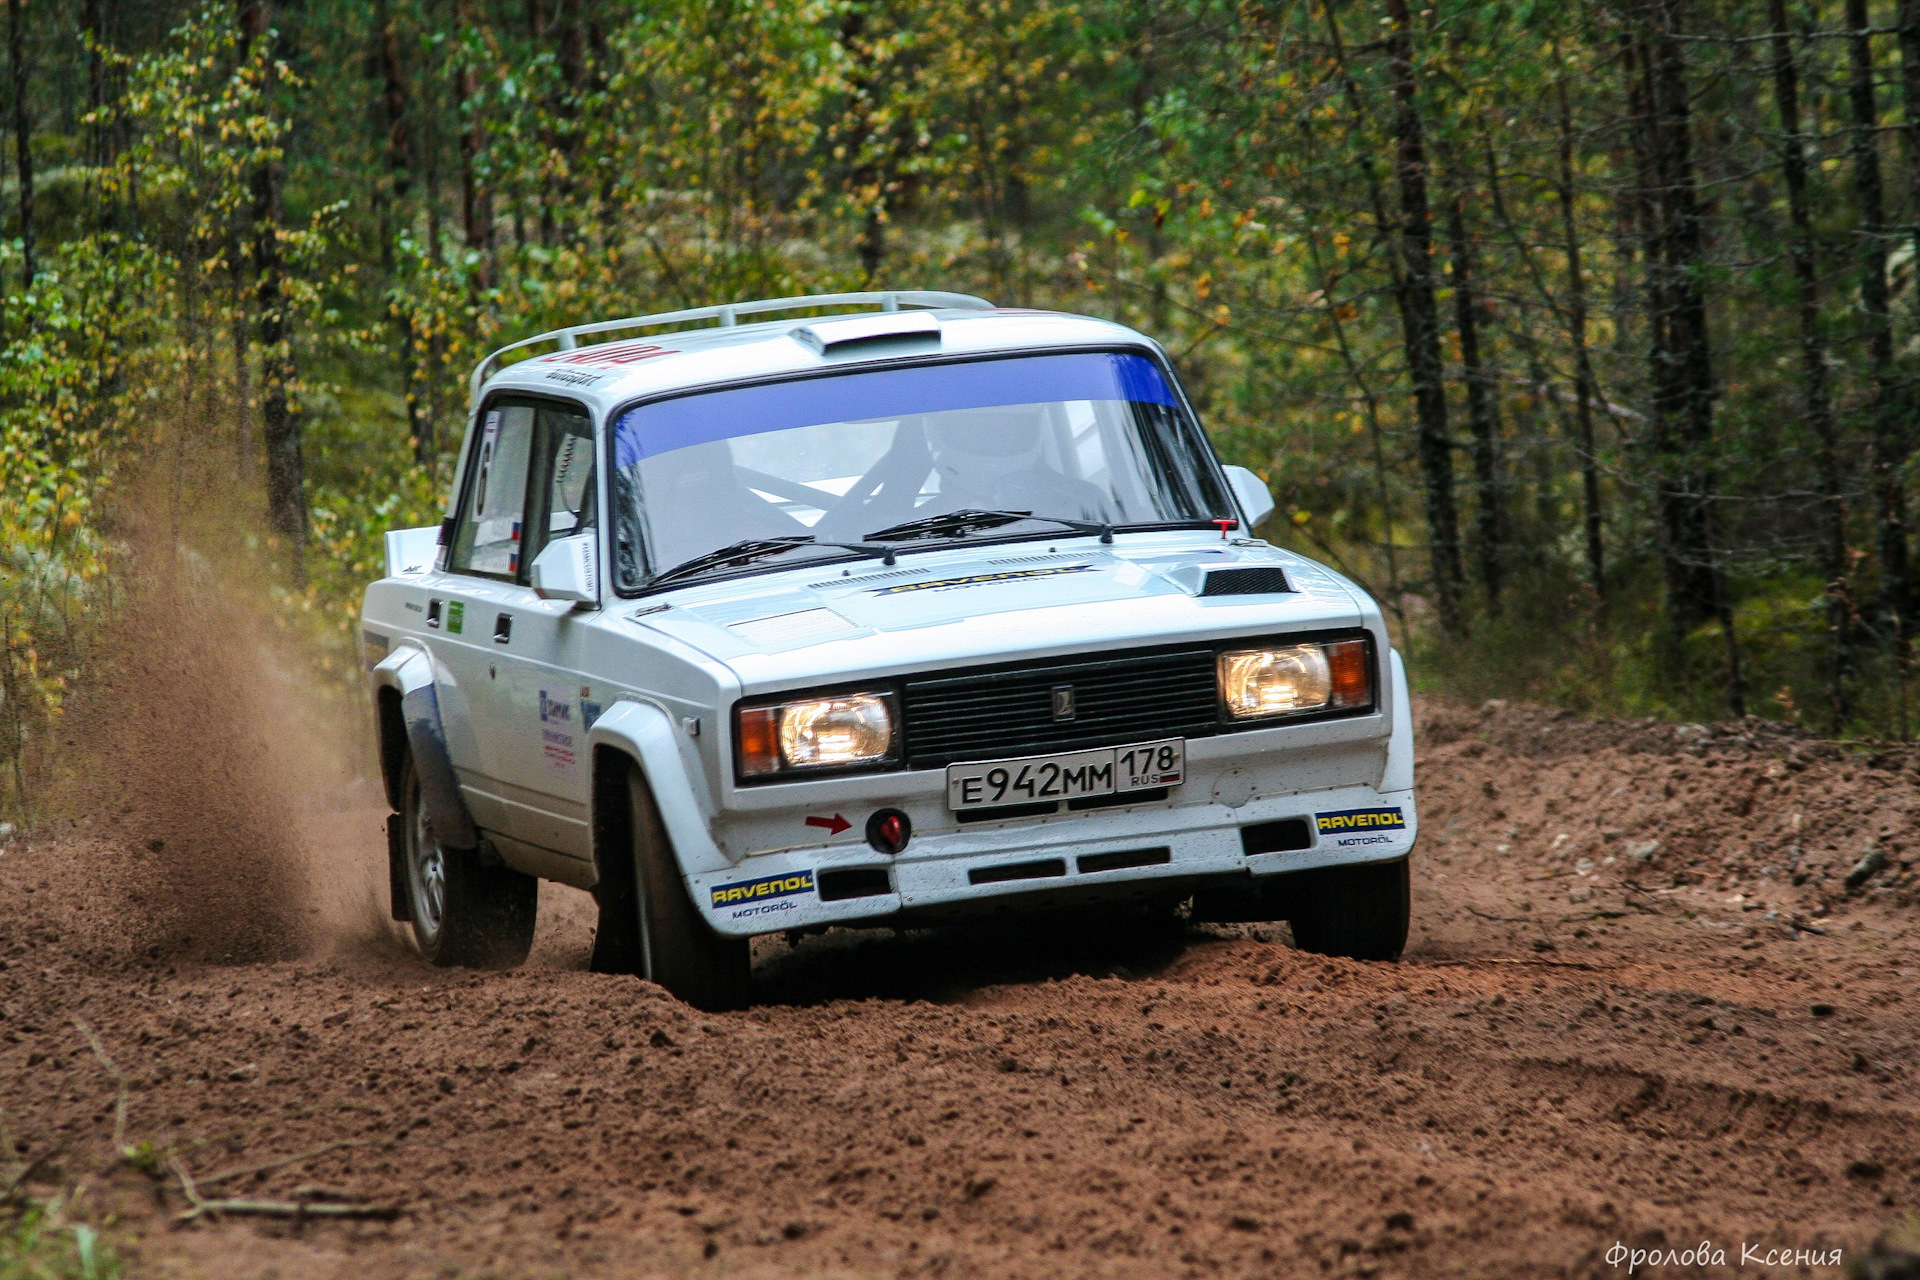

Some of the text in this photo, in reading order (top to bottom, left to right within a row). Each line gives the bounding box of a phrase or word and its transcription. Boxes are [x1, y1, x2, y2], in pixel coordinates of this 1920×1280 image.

[890, 565, 1082, 593] RAVENOL
[1120, 745, 1174, 777] 178
[961, 761, 1113, 804] E942MM
[1131, 773, 1161, 787] RUS
[1317, 812, 1404, 830] RAVENOL
[1338, 834, 1393, 847] MOTORÖL
[711, 875, 814, 904] RAVENOL
[732, 900, 798, 920] MOTORÖL
